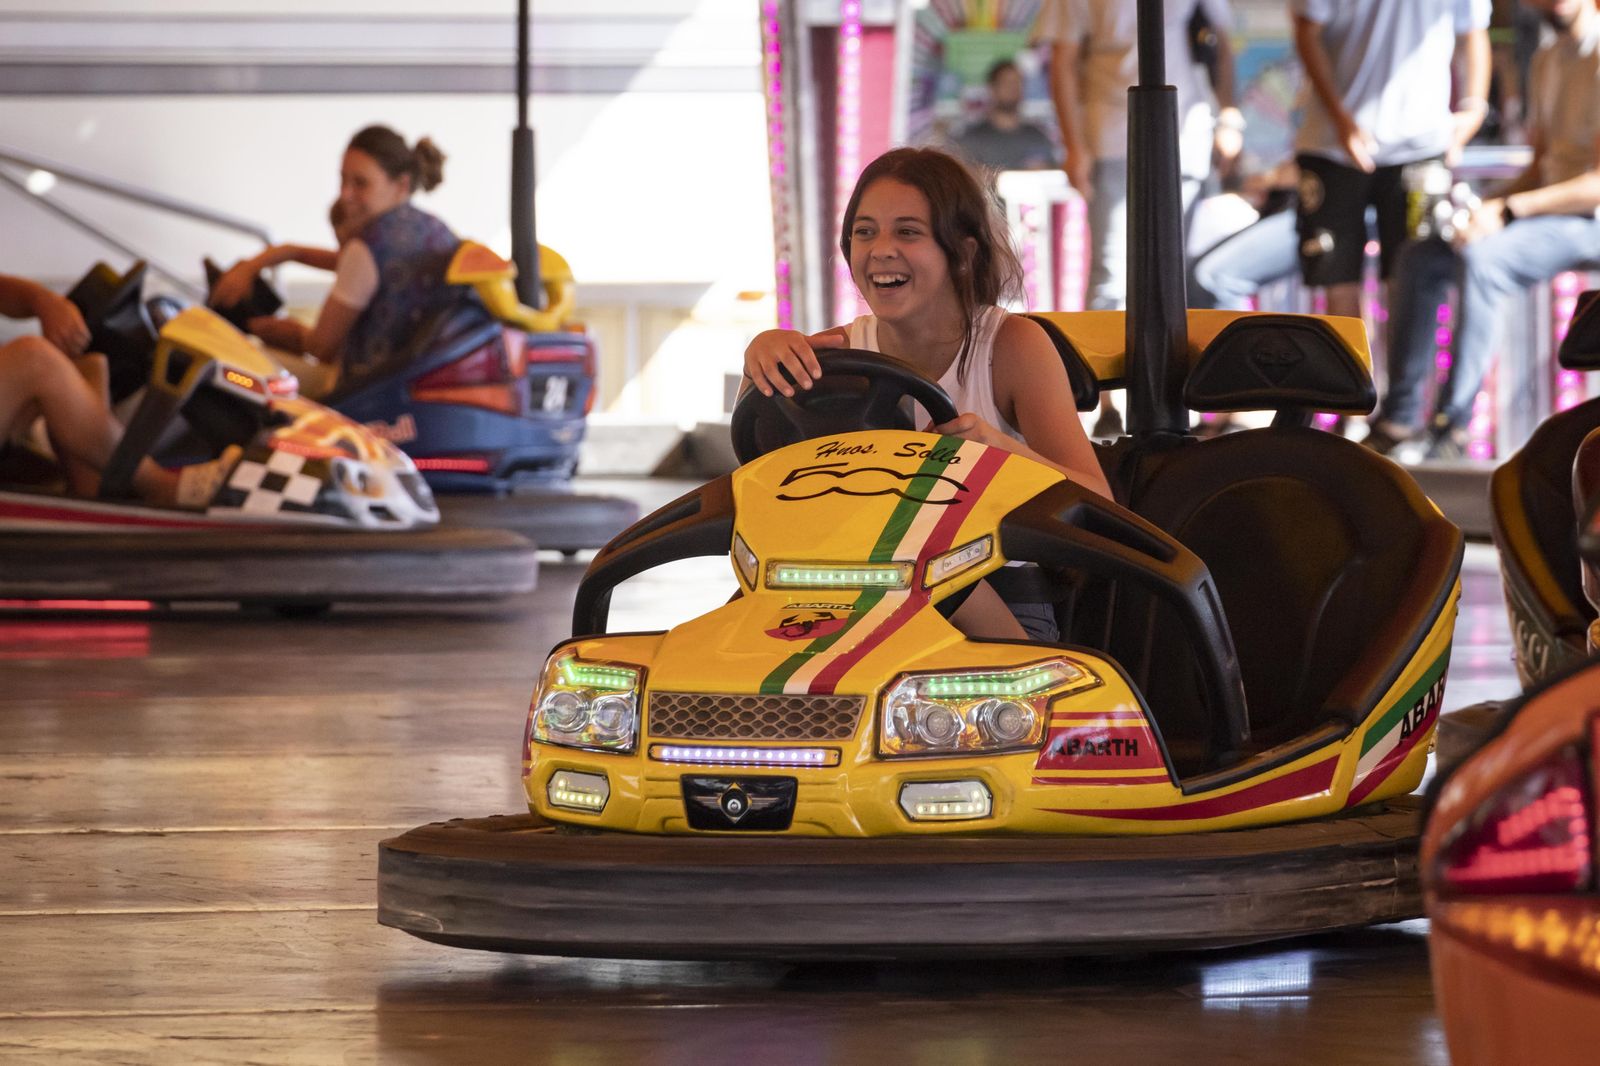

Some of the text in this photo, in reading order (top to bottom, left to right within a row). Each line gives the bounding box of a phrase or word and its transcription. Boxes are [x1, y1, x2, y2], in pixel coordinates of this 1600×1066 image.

[815, 441, 962, 465] Hnos. Sollo
[775, 462, 970, 505] 500
[786, 602, 855, 610] ABARTH
[1047, 737, 1138, 757] ABARTH
